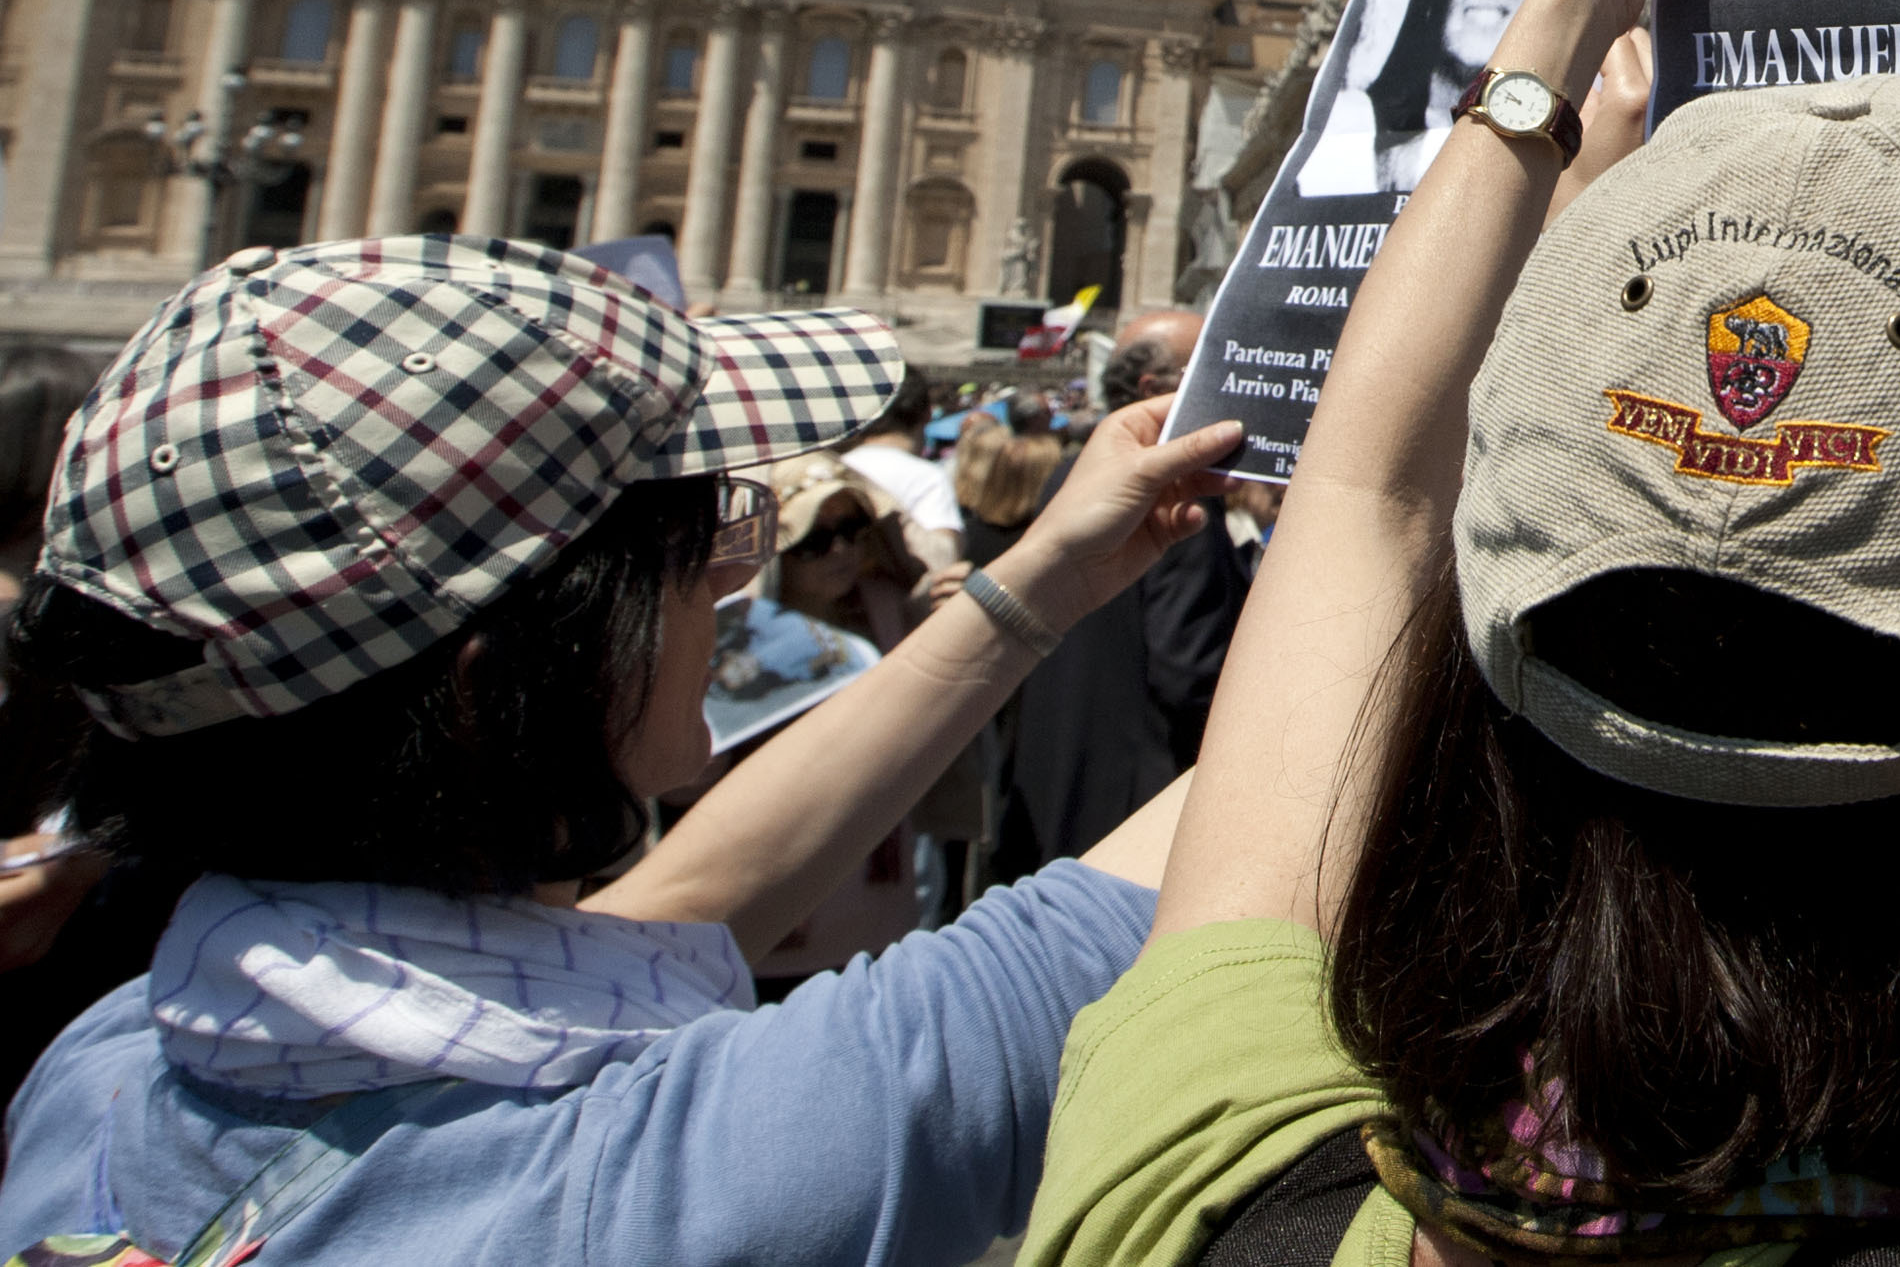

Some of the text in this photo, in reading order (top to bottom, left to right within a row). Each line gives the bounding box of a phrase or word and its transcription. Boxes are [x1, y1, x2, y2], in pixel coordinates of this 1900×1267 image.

[1285, 285, 1349, 307] ROMA
[1223, 339, 1306, 369] Partenza
[1220, 372, 1285, 399] Arrivo
[1620, 400, 1863, 479] VENI VIDI VICI
[1275, 457, 1287, 474] il
